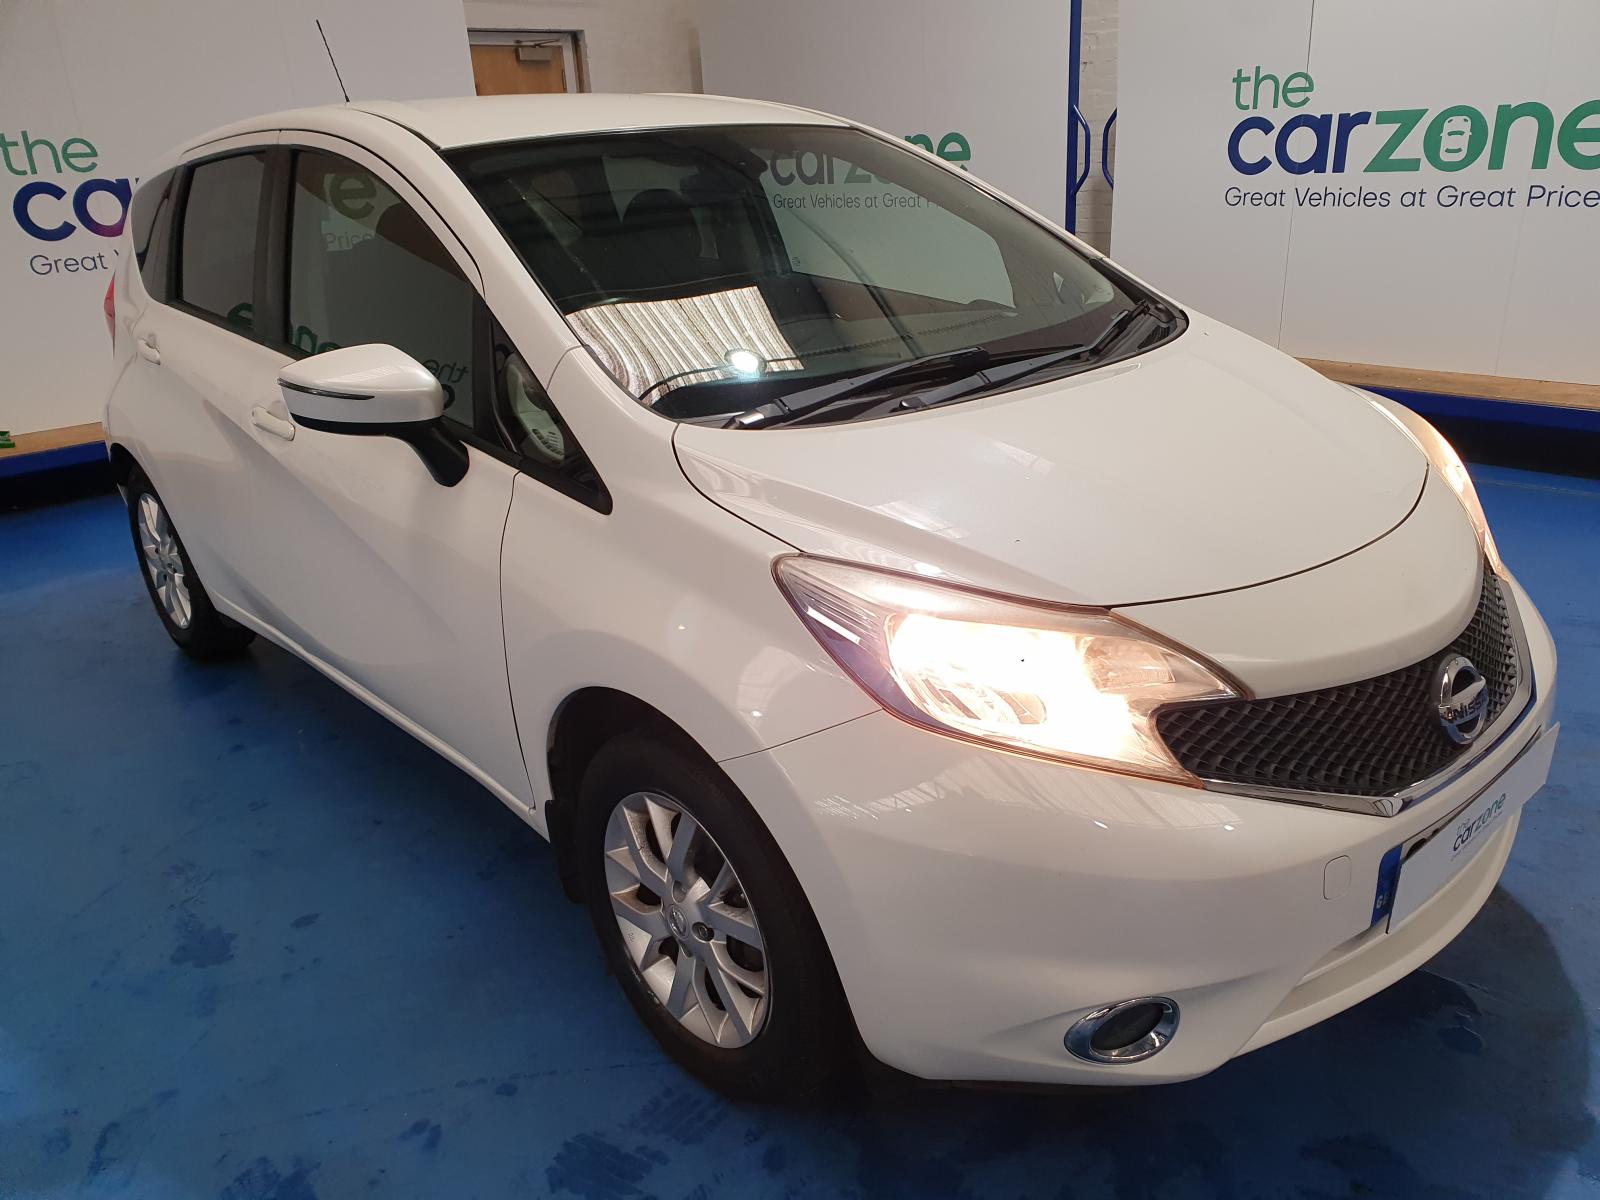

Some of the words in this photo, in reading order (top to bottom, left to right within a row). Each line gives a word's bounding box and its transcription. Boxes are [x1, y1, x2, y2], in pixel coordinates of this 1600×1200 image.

[1232, 65, 1315, 111] the
[0, 130, 98, 176] the
[1227, 99, 1600, 176] carzone
[773, 193, 806, 209] Great
[809, 193, 861, 209] Vehicles
[864, 193, 879, 209] at
[882, 192, 921, 208] Great
[1224, 186, 1286, 207] Great
[1294, 186, 1391, 207] Vehicles
[1400, 188, 1426, 207] at
[1436, 185, 1516, 208] Great
[1526, 184, 1600, 208] Price
[30, 252, 108, 275] Great
[1453, 792, 1506, 852] carzone
